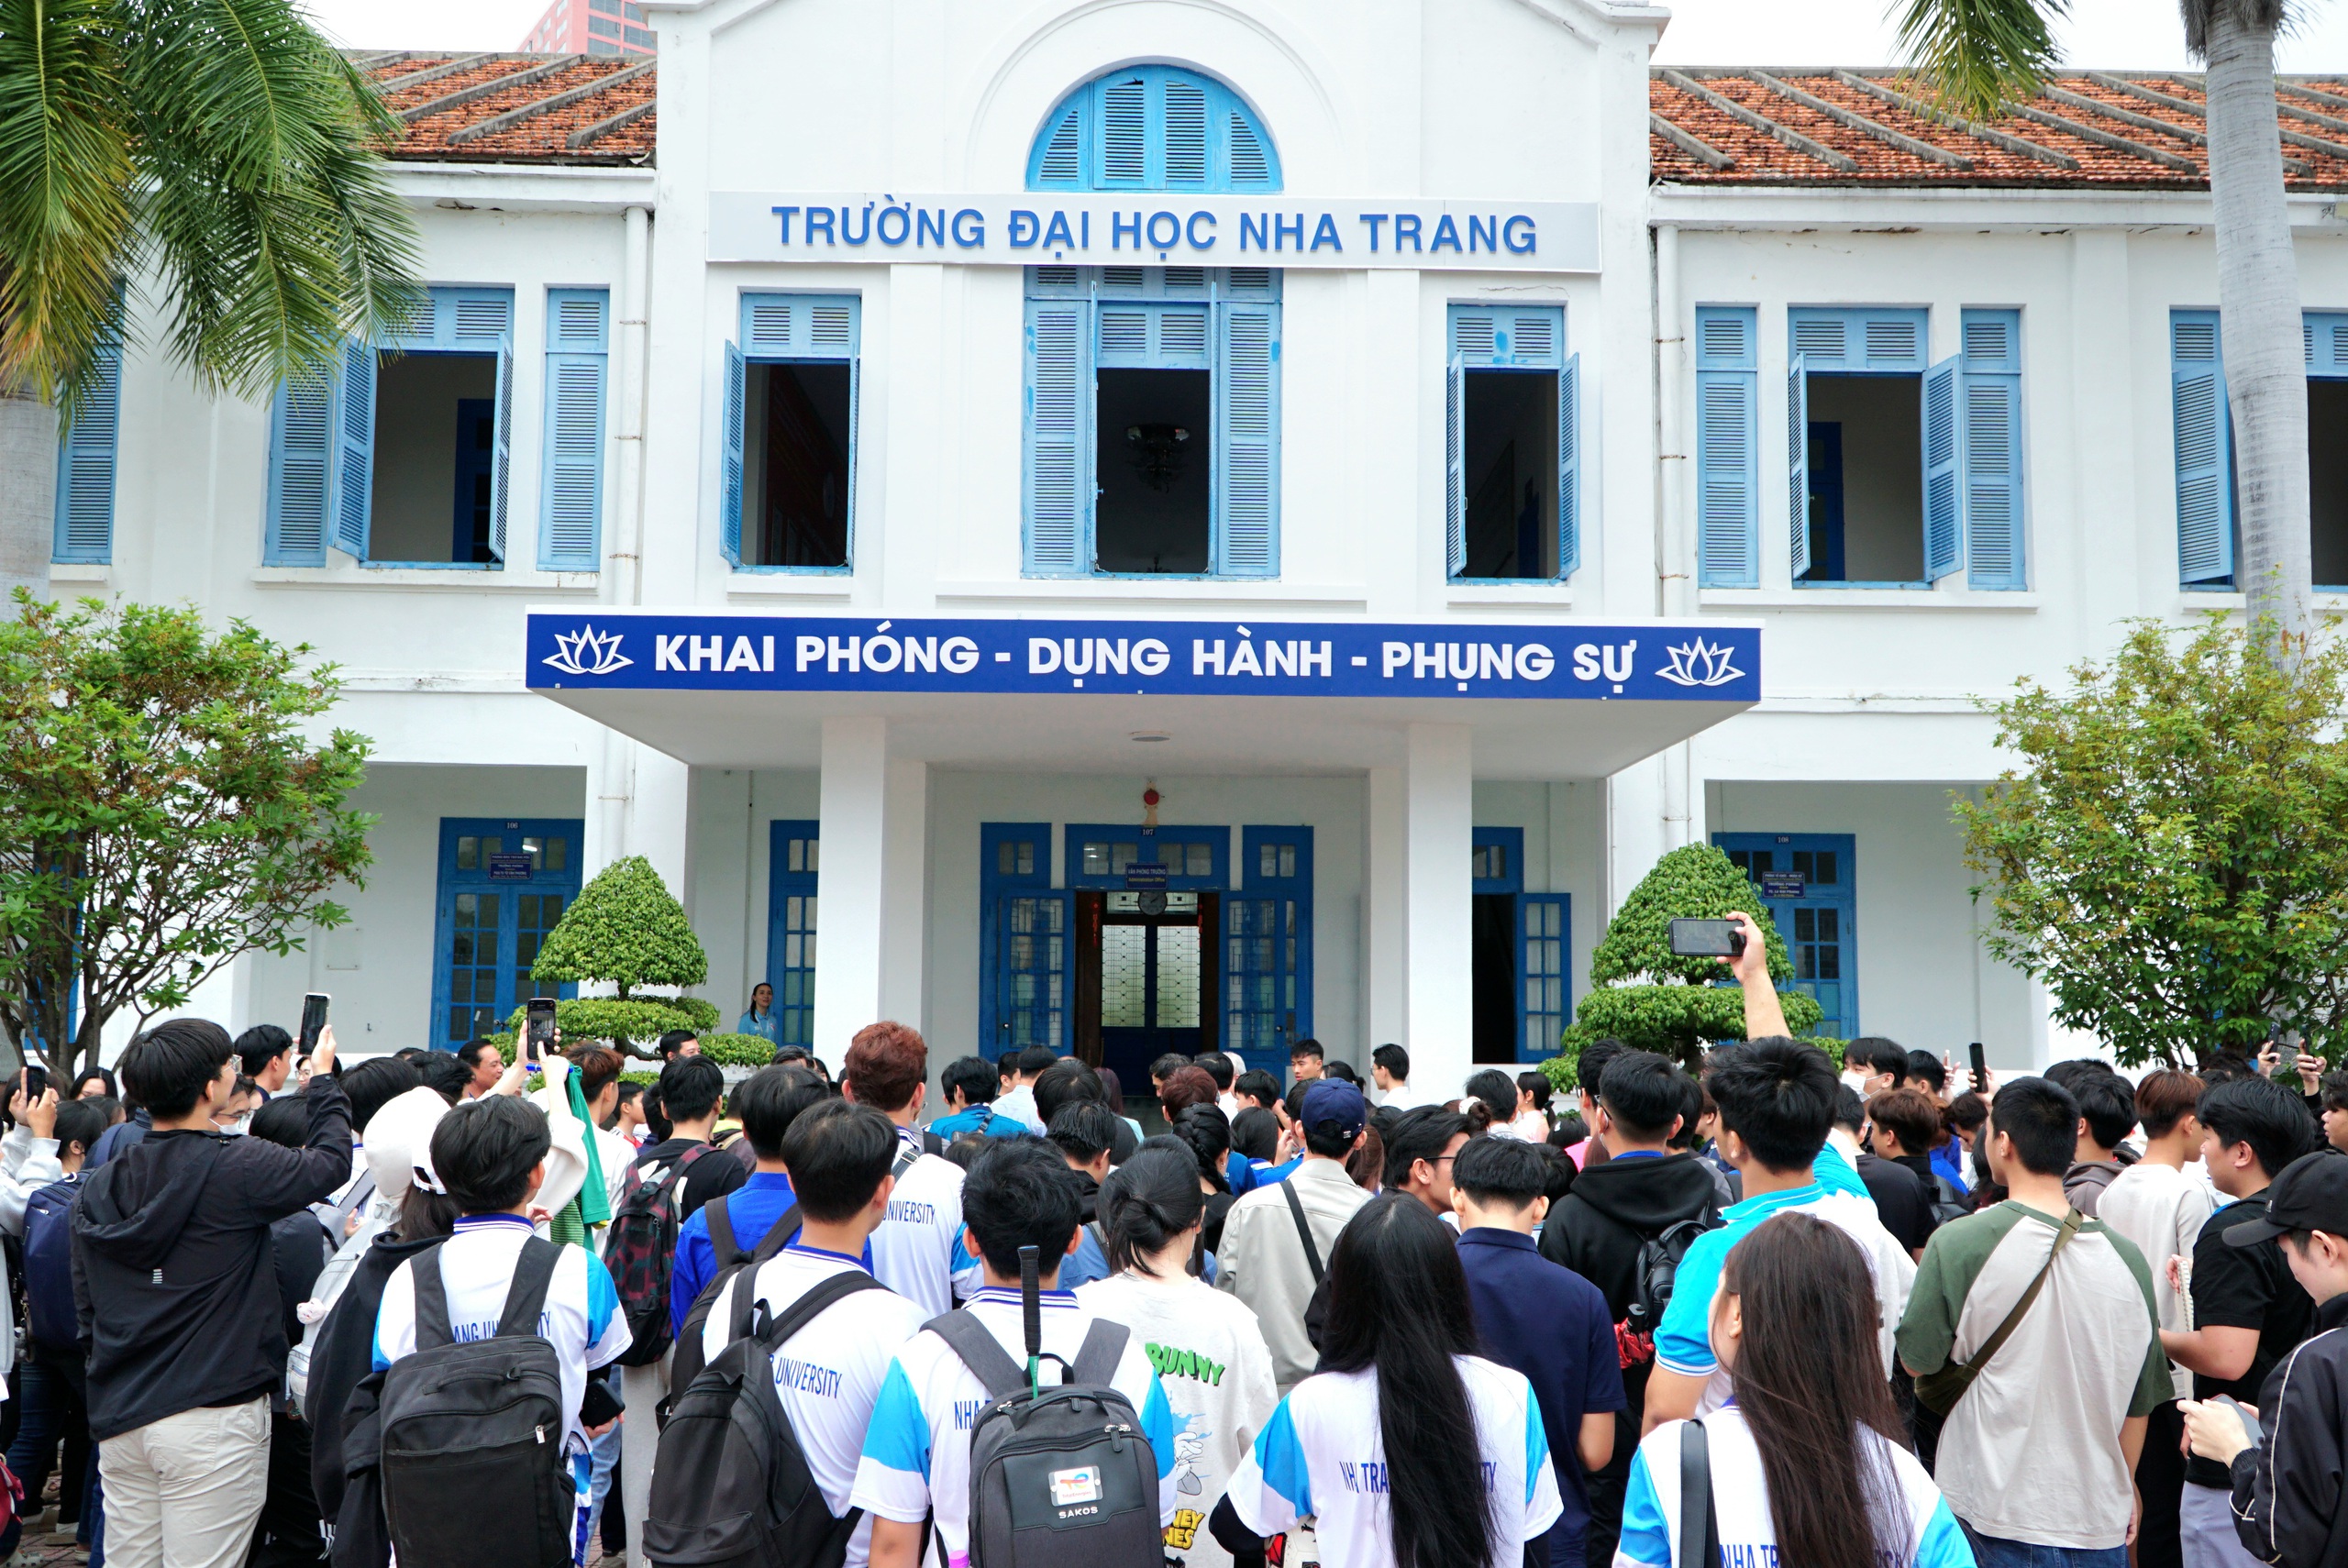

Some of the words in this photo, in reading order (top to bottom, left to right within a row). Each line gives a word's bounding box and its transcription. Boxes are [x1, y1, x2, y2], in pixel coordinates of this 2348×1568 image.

[771, 194, 985, 249] TRƯỜNG
[1008, 210, 1089, 259] ĐẠI
[1112, 211, 1217, 260] HỌC
[1240, 213, 1343, 252] NHA
[1359, 214, 1536, 254] TRANG
[656, 635, 774, 672] KHAI
[796, 620, 979, 674] PHÓNG
[995, 652, 1010, 662] -
[1029, 638, 1170, 688] DỤNG
[1193, 625, 1332, 677] HÀNH
[1351, 656, 1368, 667] -
[1383, 642, 1555, 691] PHỤNG
[1573, 639, 1637, 694] SỰ
[1142, 828, 1154, 836] 107
[775, 1357, 843, 1399] UNIVERSITY
[1145, 1342, 1225, 1387] BUNNY
[1058, 1506, 1099, 1519] SAKOS
